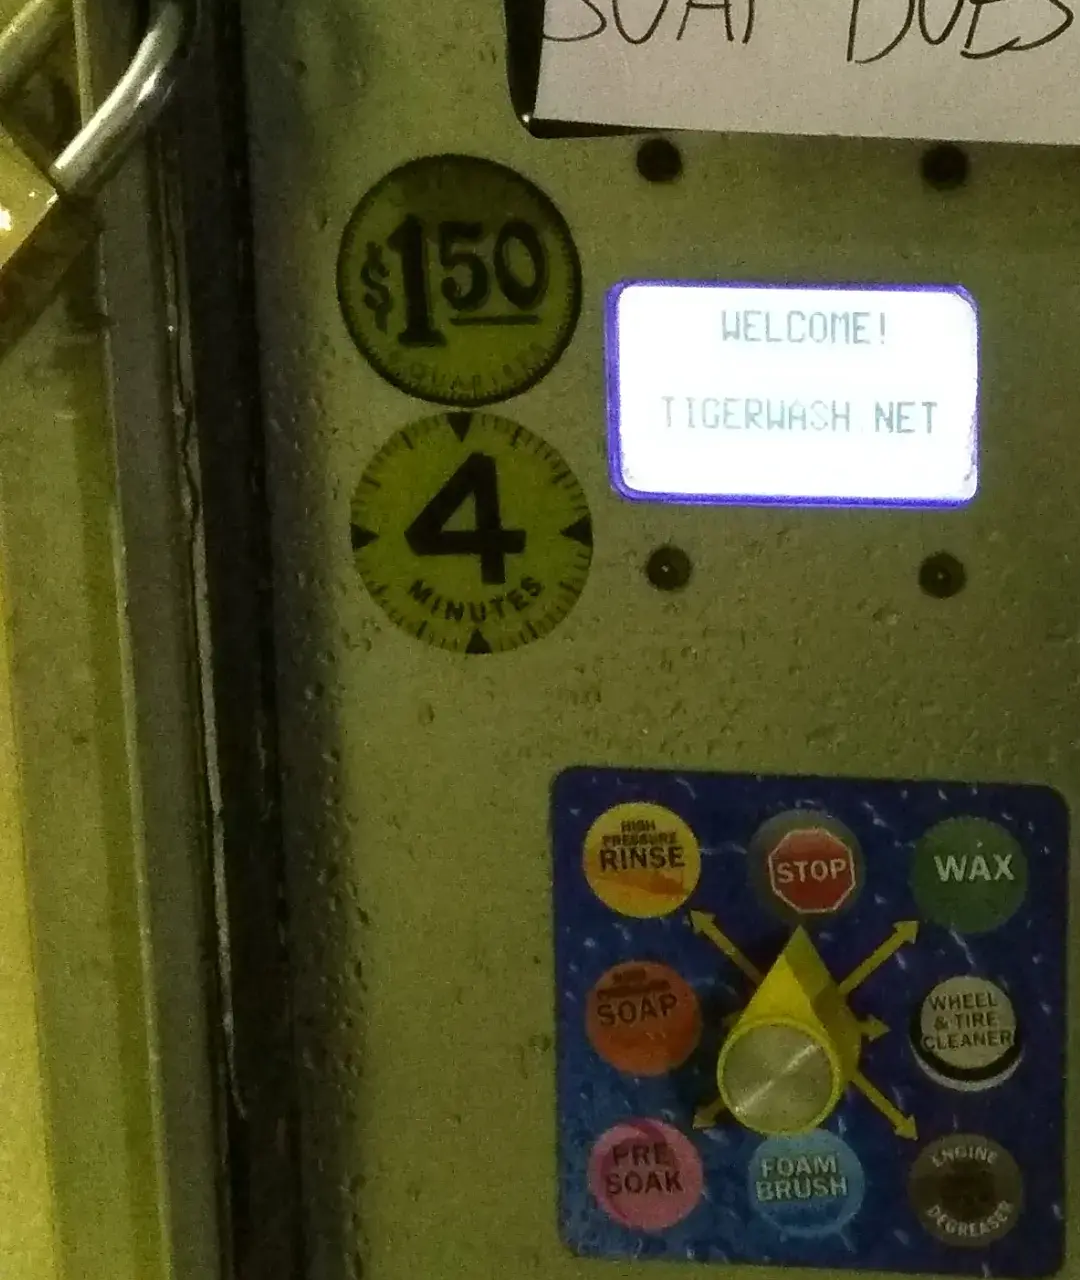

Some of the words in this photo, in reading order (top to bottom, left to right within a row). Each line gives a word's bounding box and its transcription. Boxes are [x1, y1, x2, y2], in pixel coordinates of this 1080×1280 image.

[721, 309, 887, 346] WELCOME!
[404, 451, 527, 586] 4
[407, 575, 546, 623] MINUTES
[600, 846, 685, 872] RINSE
[776, 857, 847, 883] STOP
[934, 853, 1015, 882] WAX
[597, 993, 677, 1026] SOAP
[929, 991, 998, 1011] WHEEL
[934, 1014, 949, 1030] &
[954, 1011, 998, 1029] TIRE
[923, 1029, 1013, 1051] CLEANER
[612, 1141, 669, 1167] PRE
[759, 1154, 838, 1179] FOAM
[930, 1143, 998, 1168] ENGINE
[606, 1167, 682, 1196] SOAK
[755, 1175, 849, 1202] BRUSH
